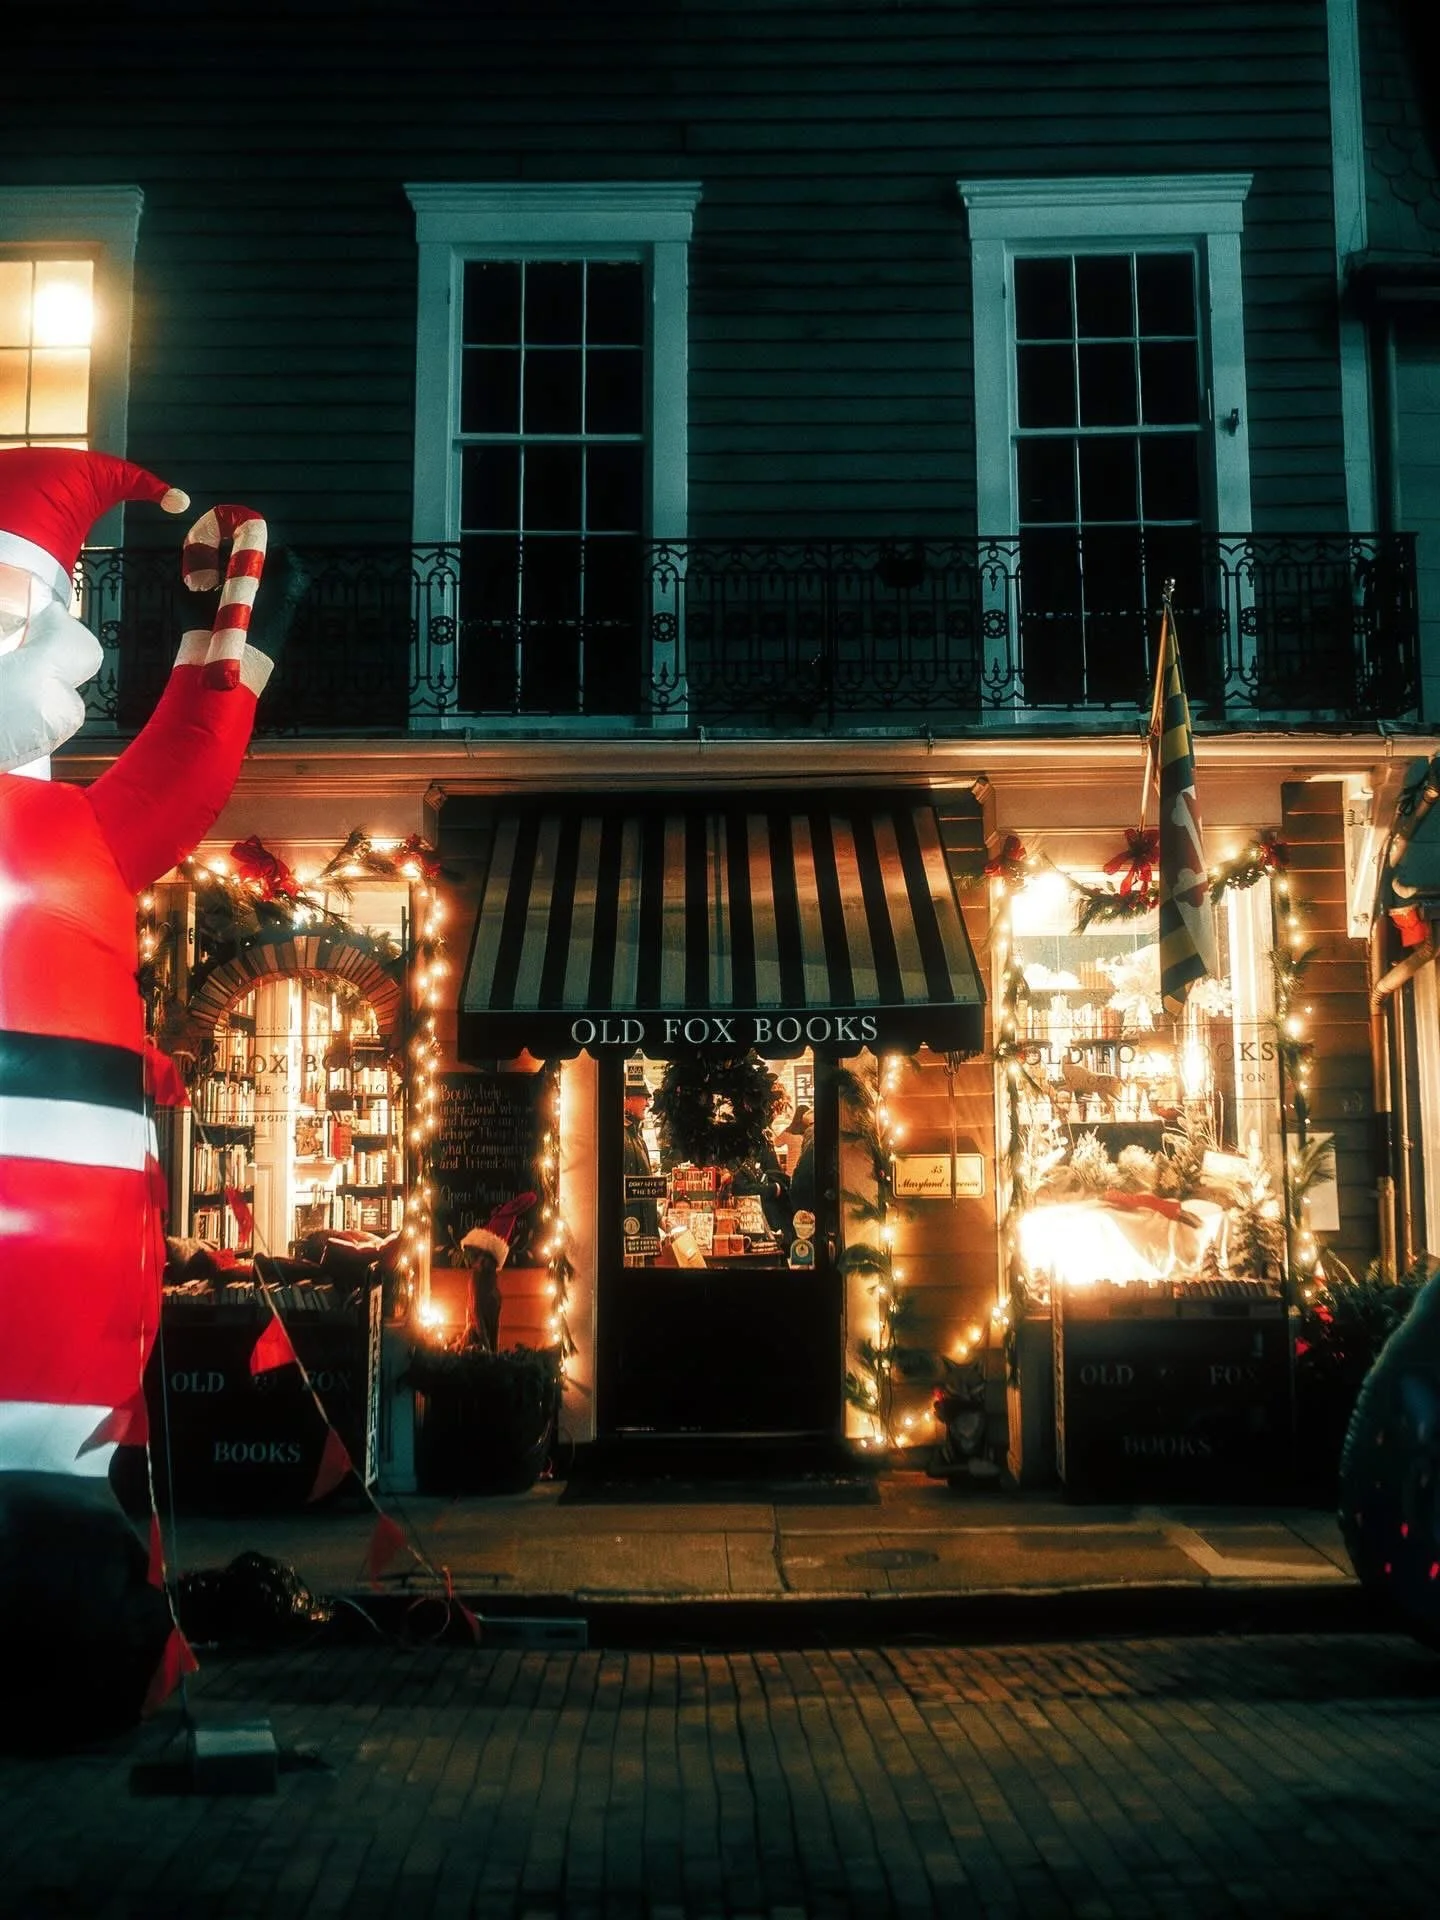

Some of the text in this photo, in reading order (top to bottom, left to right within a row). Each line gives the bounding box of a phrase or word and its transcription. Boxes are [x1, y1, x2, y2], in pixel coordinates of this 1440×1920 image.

[570, 1015, 879, 1045] OLD FOX BOOKS
[229, 1054, 288, 1074] FOX
[1024, 1044, 1084, 1065] OLD
[254, 1114, 294, 1123] BEGIN
[897, 1177, 945, 1192] Maryland
[170, 1370, 225, 1393] OLD
[1079, 1363, 1135, 1386] OLD
[213, 1440, 302, 1464] BOOKS
[1123, 1434, 1214, 1458] BOOKS
